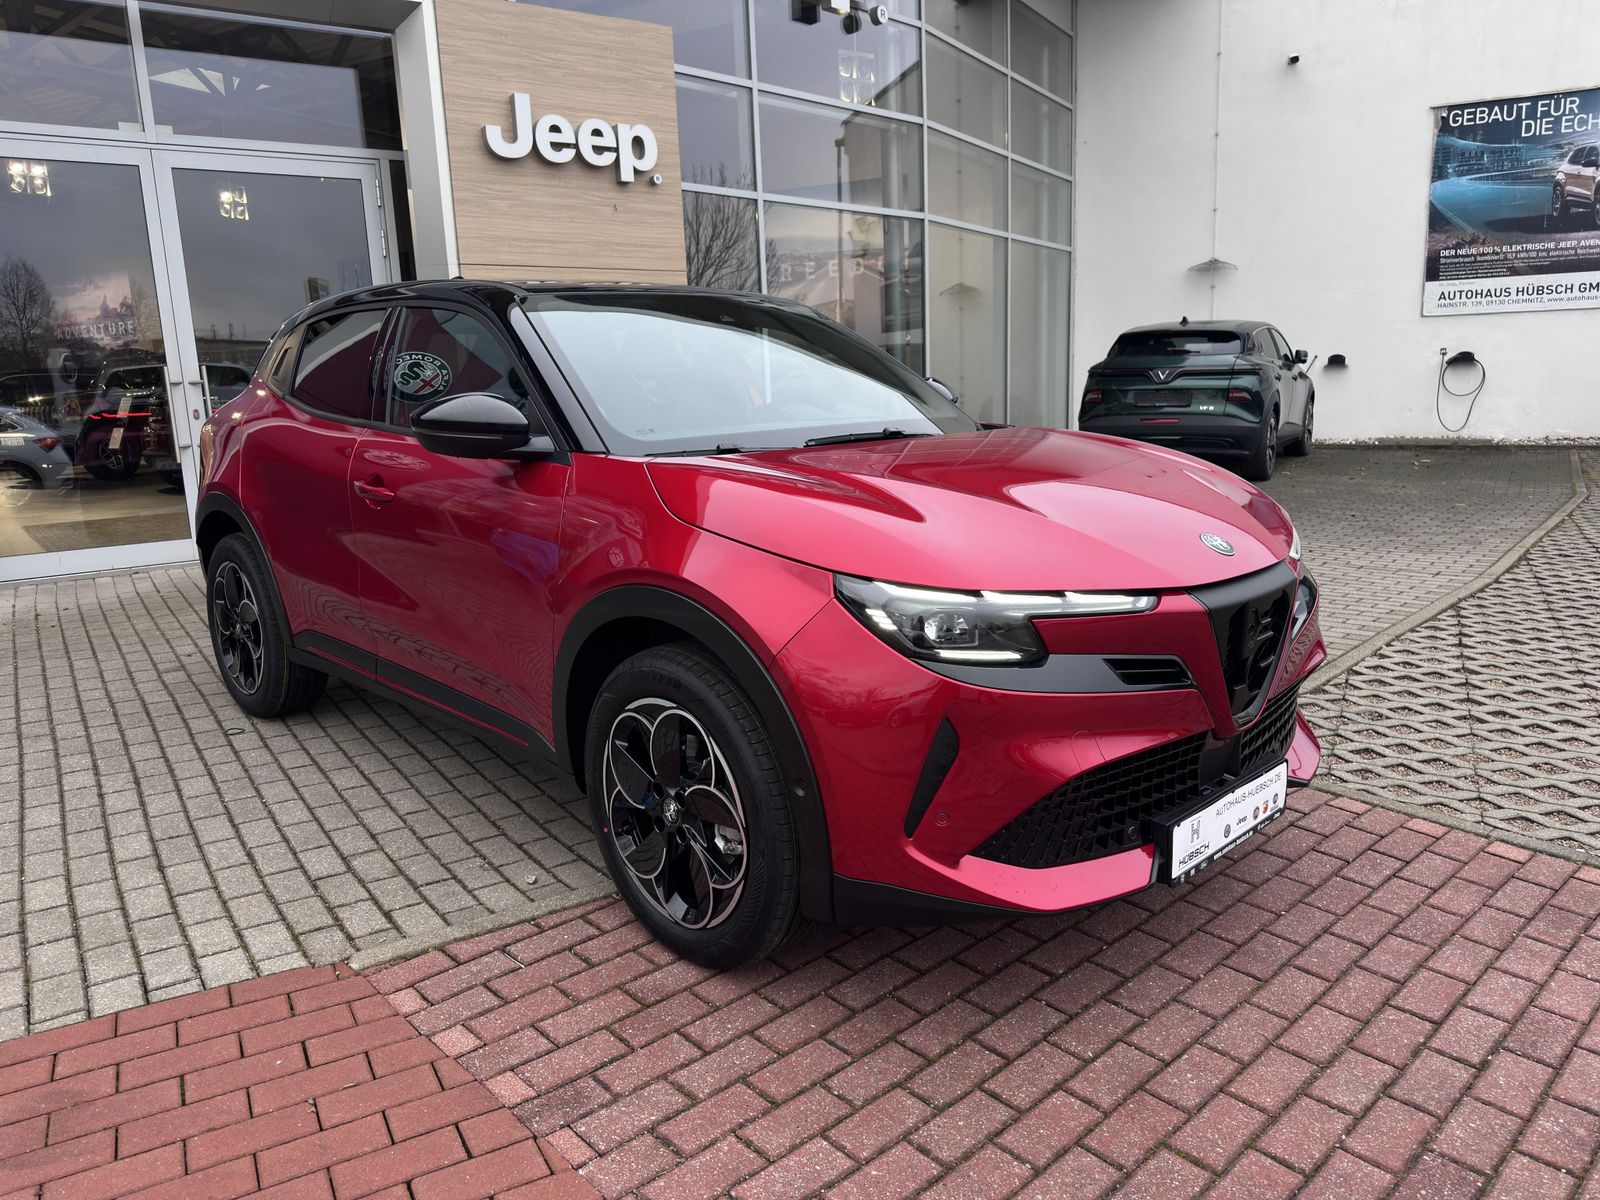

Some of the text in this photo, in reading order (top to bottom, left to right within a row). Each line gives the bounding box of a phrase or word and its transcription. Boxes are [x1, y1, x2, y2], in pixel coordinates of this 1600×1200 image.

[1449, 94, 1579, 127] GEBAUT FÜR
[1521, 117, 1554, 137] DIE
[482, 92, 658, 183] Jeep
[1440, 249, 1456, 257] DER
[1457, 247, 1477, 256] NEUE
[1502, 241, 1556, 253] ELEKTRISCHE
[1437, 286, 1512, 302] AUTOHAUS
[1516, 282, 1574, 297] HÜBSCH
[1437, 301, 1469, 309] HAINSTR.
[1507, 296, 1545, 305] CHEMNITZ,
[57, 320, 135, 340] ADVENTURE
[1215, 771, 1282, 817] AUTOHAUS-HUEBSCH.DE
